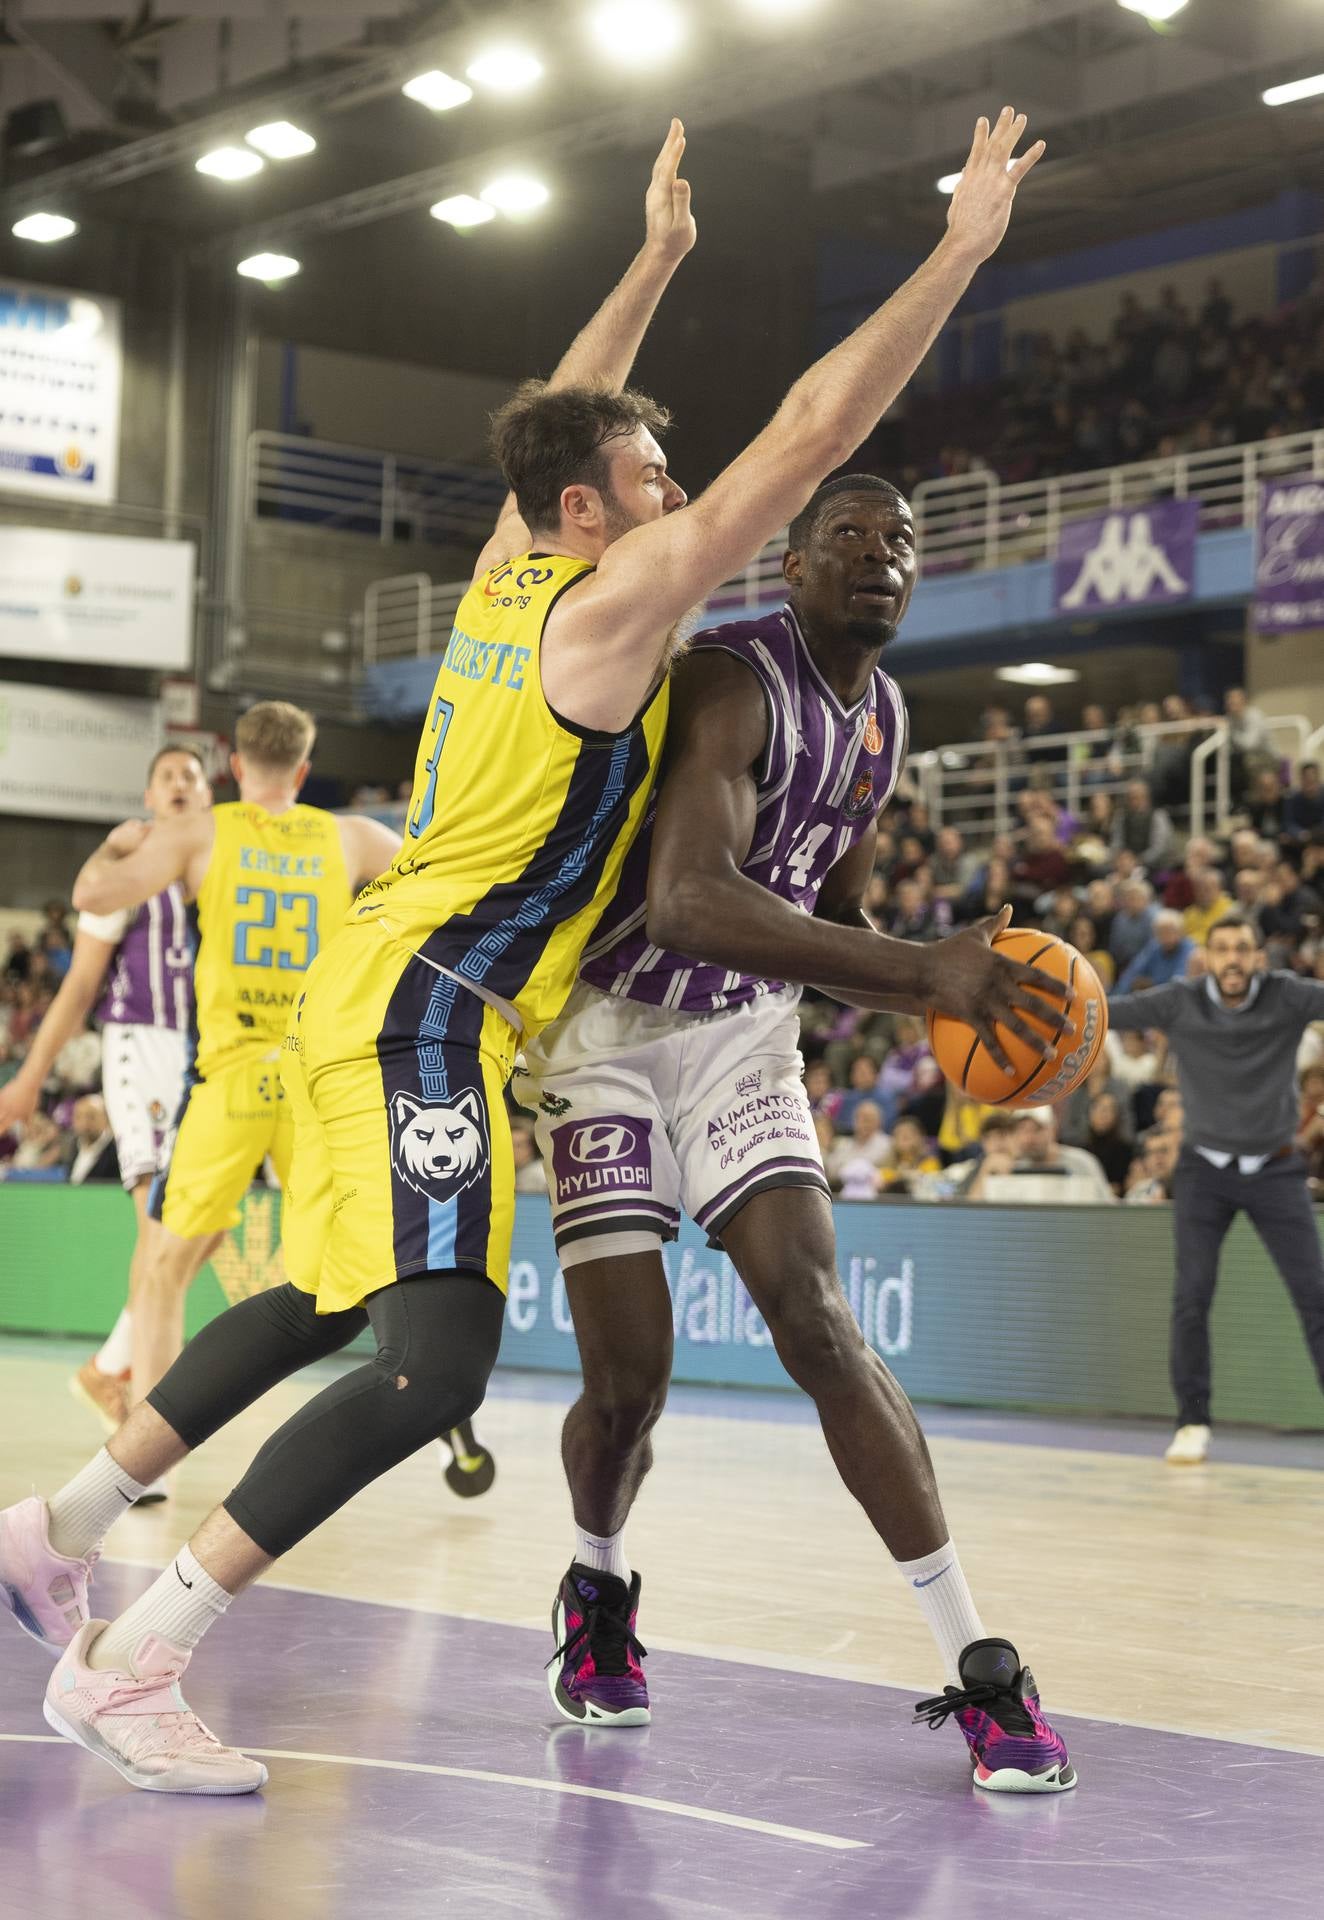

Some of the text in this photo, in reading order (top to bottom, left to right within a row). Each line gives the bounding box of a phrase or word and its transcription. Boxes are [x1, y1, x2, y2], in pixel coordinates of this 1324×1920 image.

[408, 696, 454, 839] 3
[240, 847, 325, 876] KRIKKE
[232, 886, 319, 972] 23
[1024, 998, 1099, 1101] Wilson
[707, 1095, 801, 1138] ALIMENTOS
[711, 1110, 806, 1151] DE VALLADOLID
[720, 1126, 810, 1169] A gusto de todos
[559, 1166, 650, 1197] HYUNDAI
